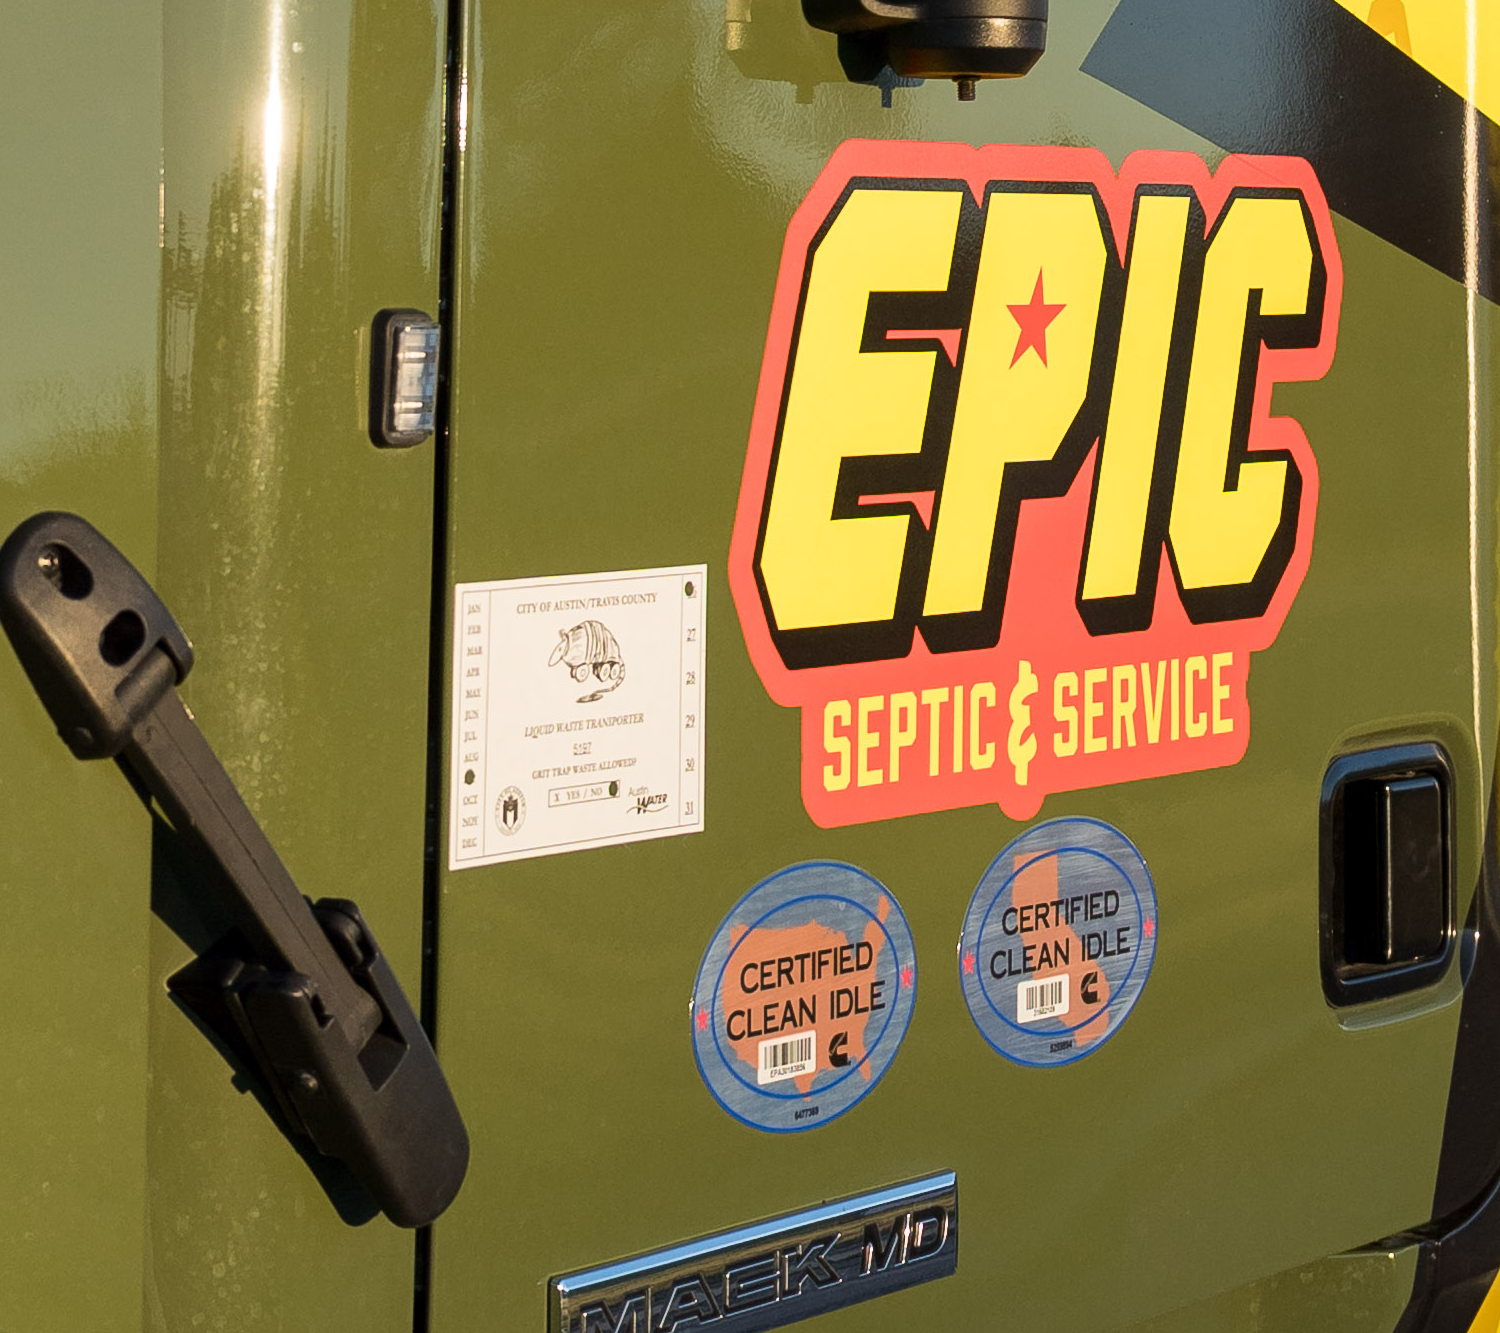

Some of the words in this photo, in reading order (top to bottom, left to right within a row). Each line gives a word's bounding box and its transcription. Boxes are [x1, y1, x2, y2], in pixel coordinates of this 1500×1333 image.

[756, 181, 1322, 651] EPIC
[517, 602, 538, 614] CITY
[540, 600, 552, 612] OF
[554, 596, 619, 611] AUSTIN/TRAVIS
[621, 593, 658, 605] COUNTY
[686, 628, 696, 642] 27
[685, 671, 696, 685] 28
[524, 723, 554, 738] LIQUID
[556, 720, 584, 733] WASTE
[585, 713, 645, 729] TRANSPORTER
[685, 714, 695, 729] 29
[822, 680, 997, 793] SEPTIC
[1007, 660, 1040, 786] &
[1052, 651, 1234, 759] SERVICE
[532, 768, 550, 779] GRIT
[552, 765, 571, 777] TRAP
[573, 763, 596, 774] WASTE
[685, 758, 695, 772] 30
[628, 785, 649, 797] Austin
[684, 801, 694, 816] 31
[1001, 890, 1120, 937] CERTIFIED
[989, 936, 1070, 980] CLEAN
[1080, 925, 1131, 962] IDLE
[740, 940, 873, 994] CERTIFIED
[726, 1001, 817, 1042] CLEAN
[829, 979, 886, 1021] IDLE
[859, 1205, 950, 1278] MD
